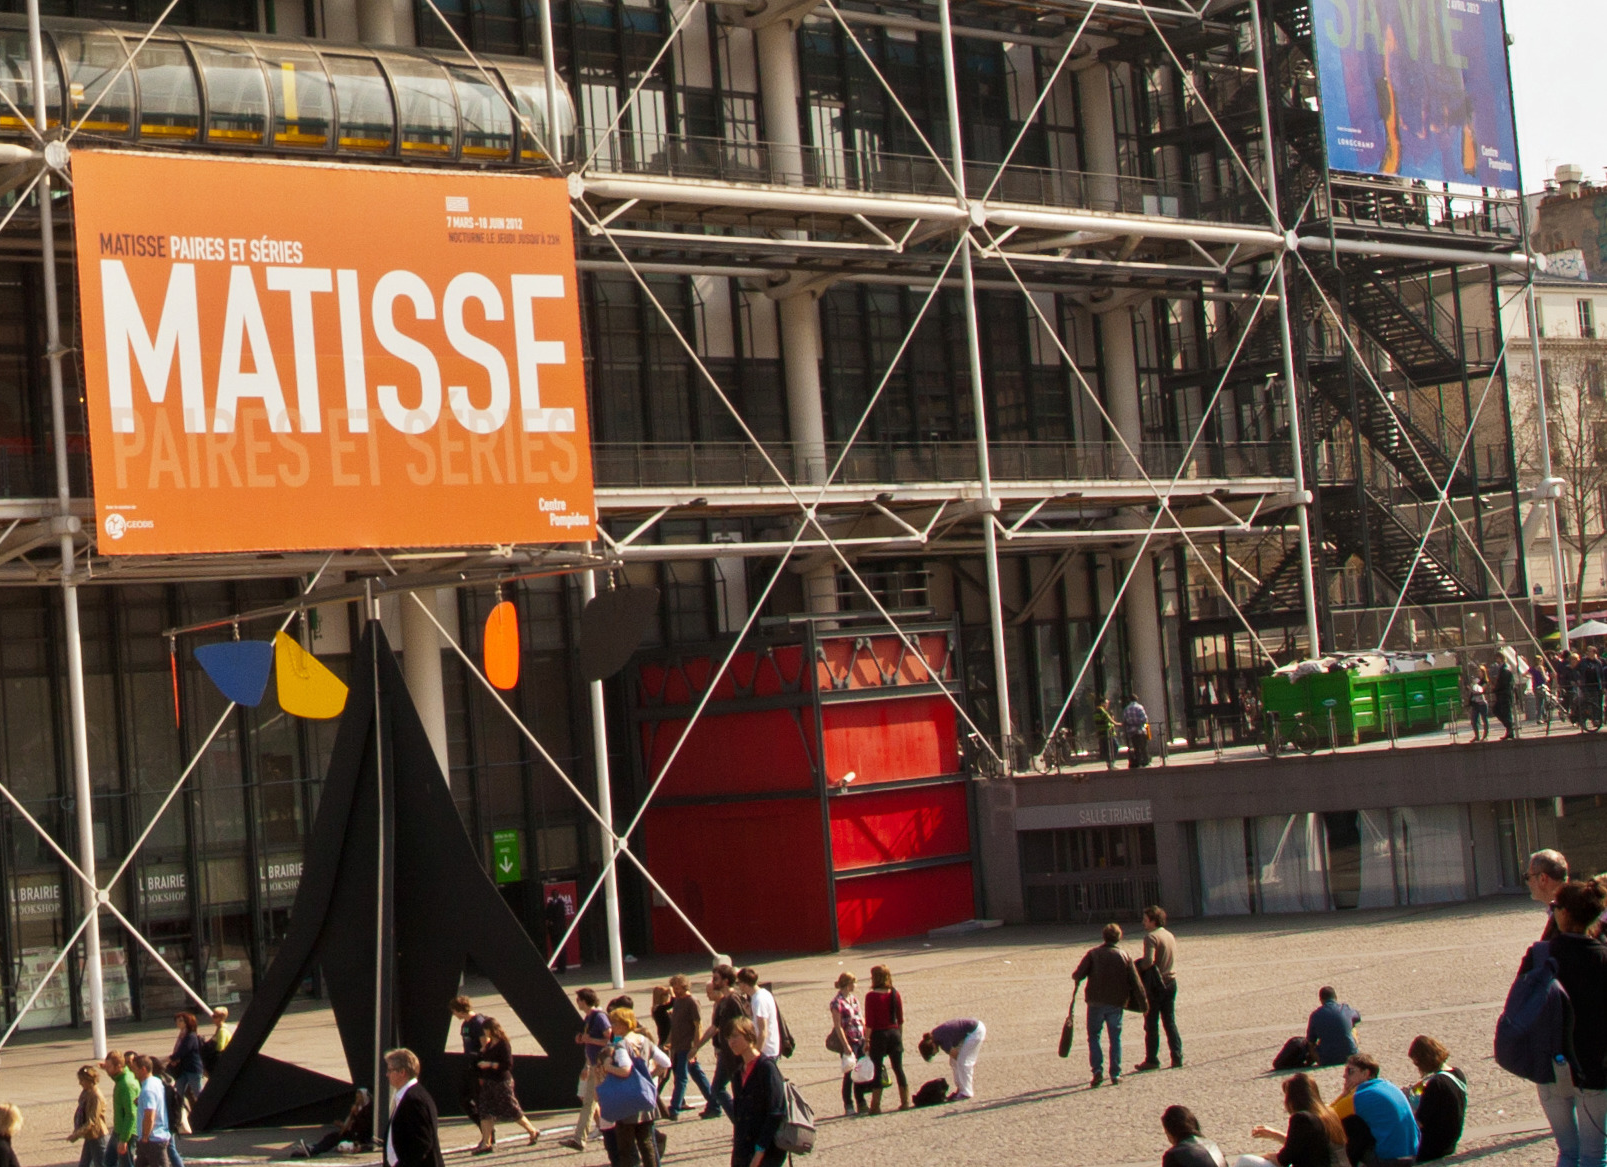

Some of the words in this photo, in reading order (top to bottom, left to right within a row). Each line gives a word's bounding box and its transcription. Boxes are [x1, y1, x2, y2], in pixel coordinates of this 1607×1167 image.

[446, 216, 452, 228] 7
[453, 216, 474, 229] MARS
[489, 217, 505, 230] JUIN
[506, 217, 523, 230] 2012
[99, 232, 167, 258] MATISSE
[170, 235, 225, 261] PAIRES
[229, 240, 247, 262] ET
[250, 234, 304, 264] SÉRIES
[100, 259, 576, 435] MATISSE
[111, 406, 311, 489] PAIRES
[326, 406, 381, 487] ET
[403, 390, 579, 487] SÉRIES
[538, 497, 567, 512] Centre
[1079, 808, 1107, 824] SALLE
[1108, 806, 1152, 823] TRIANGLE
[260, 862, 304, 879] LBRAIRIE
[139, 874, 186, 892] LBRAIRIE
